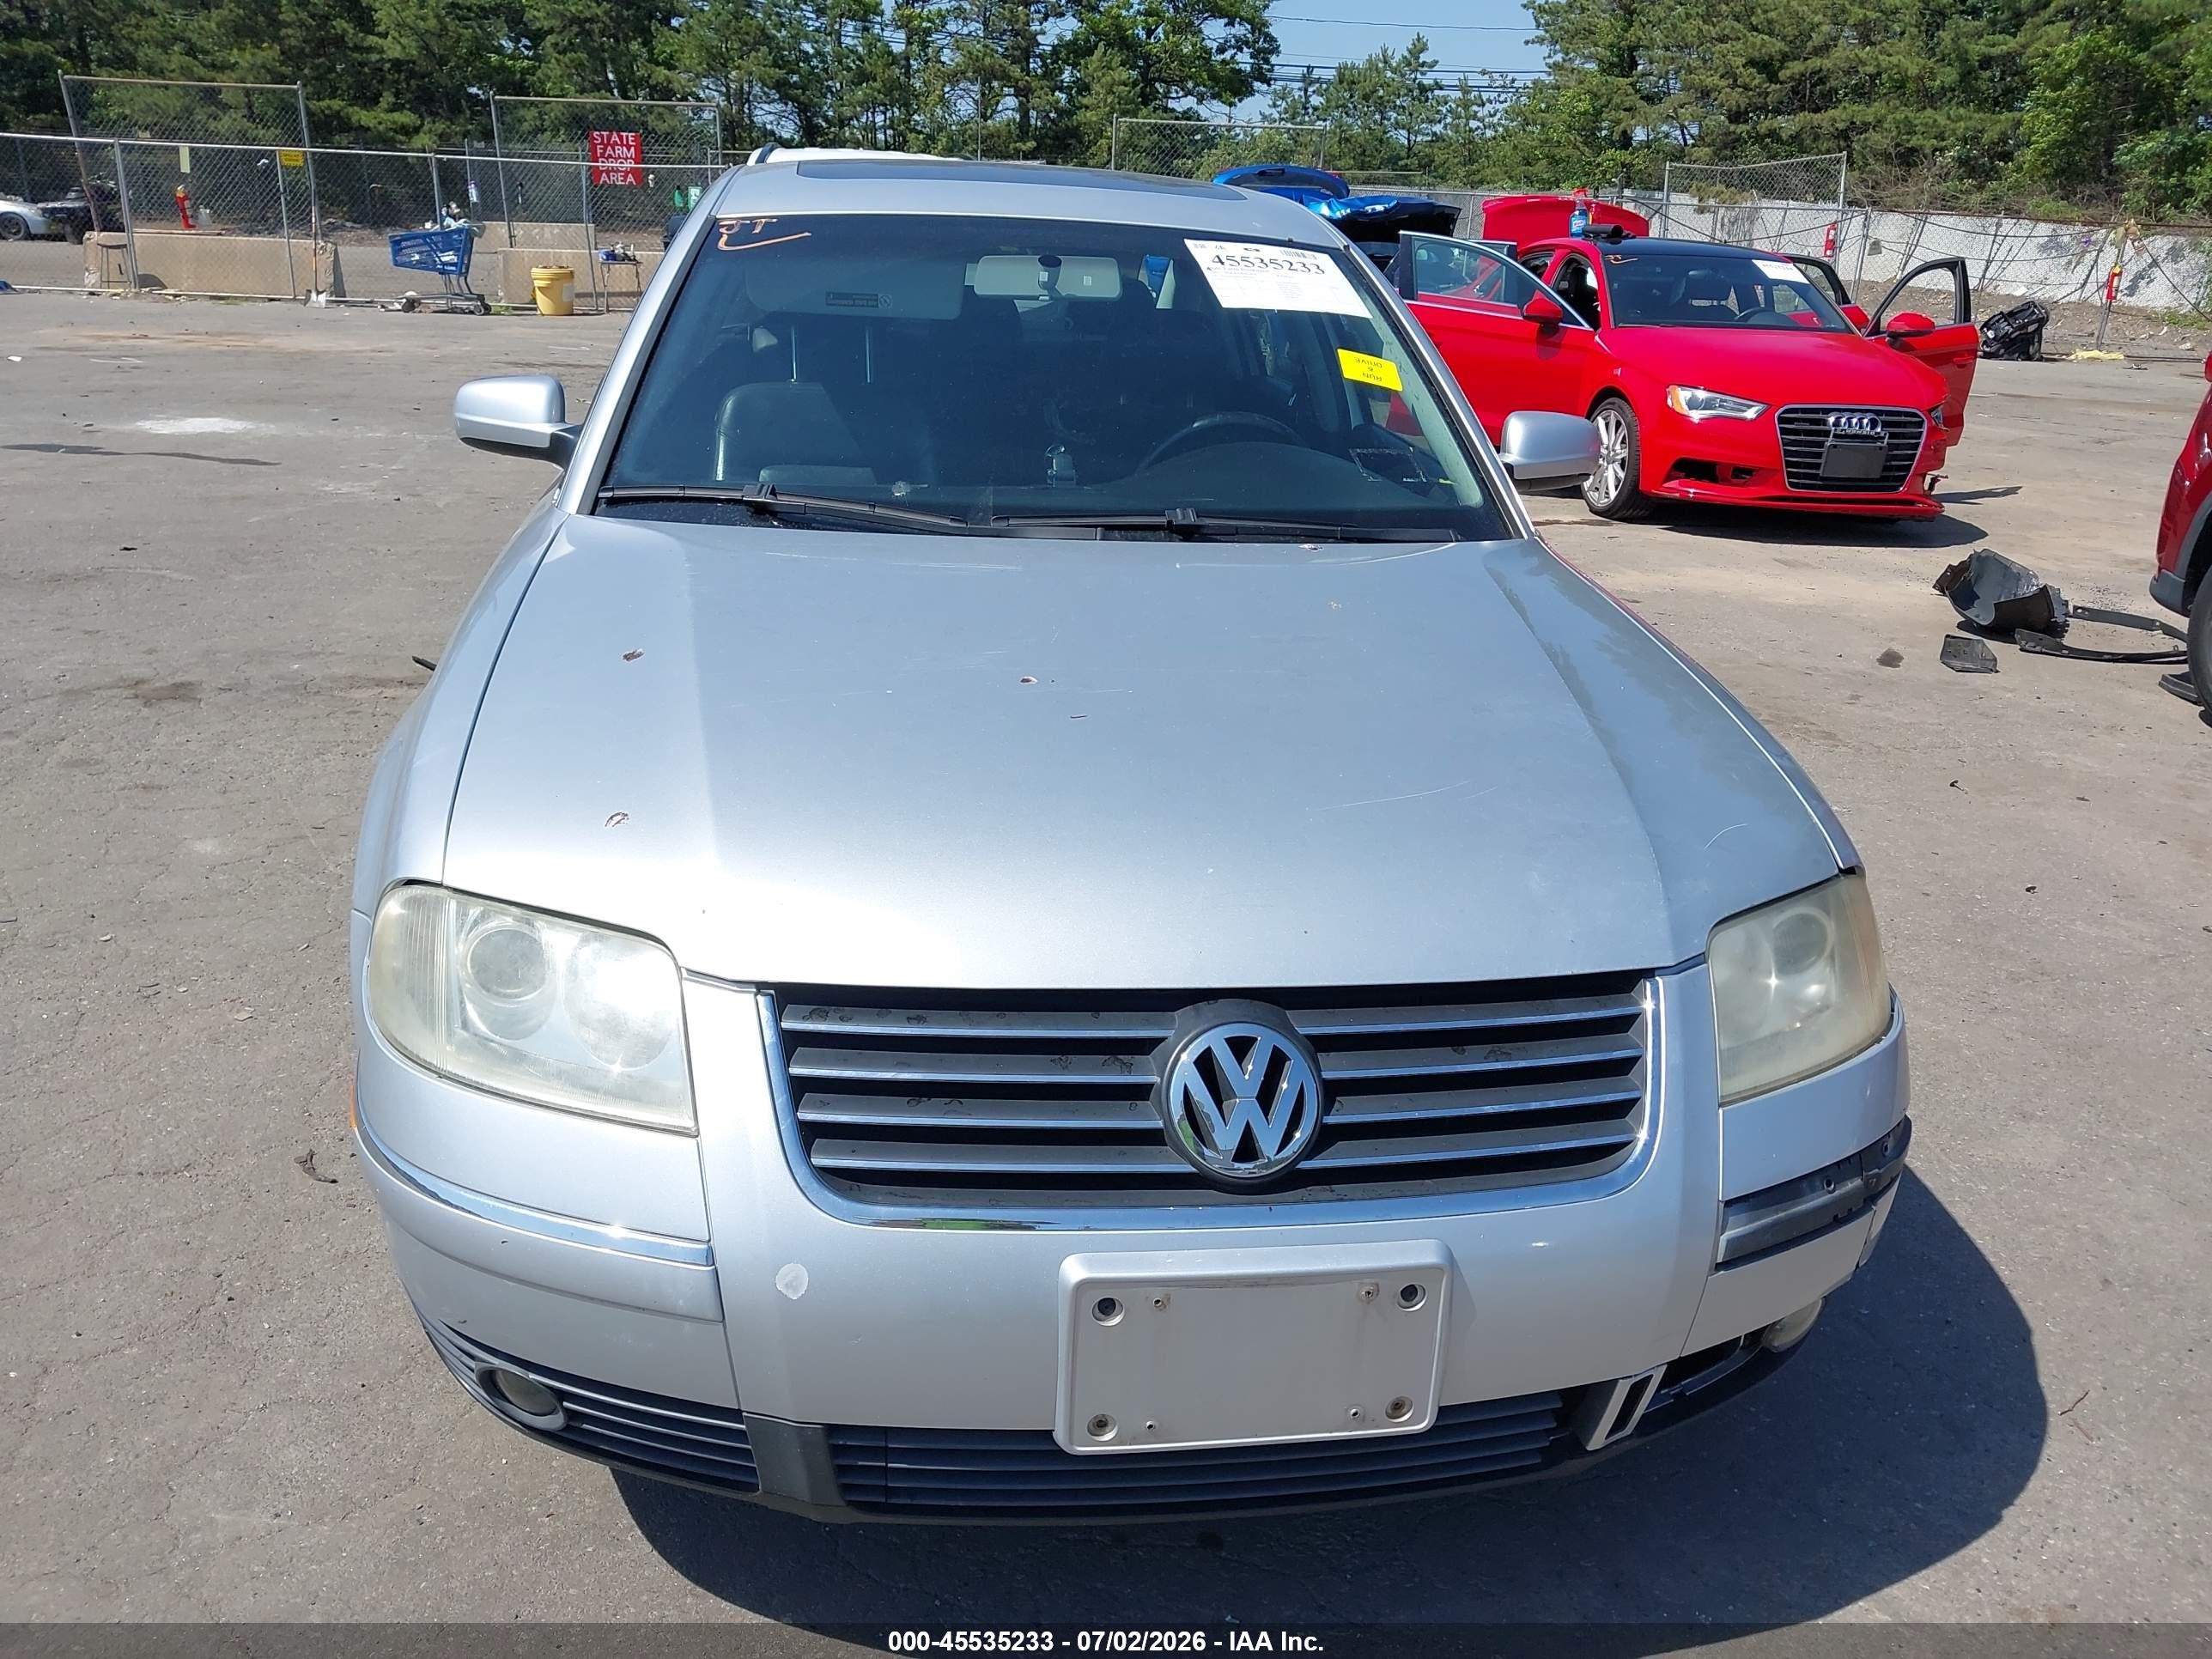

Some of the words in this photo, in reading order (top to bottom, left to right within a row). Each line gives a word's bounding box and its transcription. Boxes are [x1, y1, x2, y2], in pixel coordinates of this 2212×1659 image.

[592, 131, 636, 145] STATE
[596, 145, 635, 159] FARM
[599, 158, 635, 172] DROP
[599, 172, 636, 185] AREA
[1211, 254, 1326, 276] 45535233
